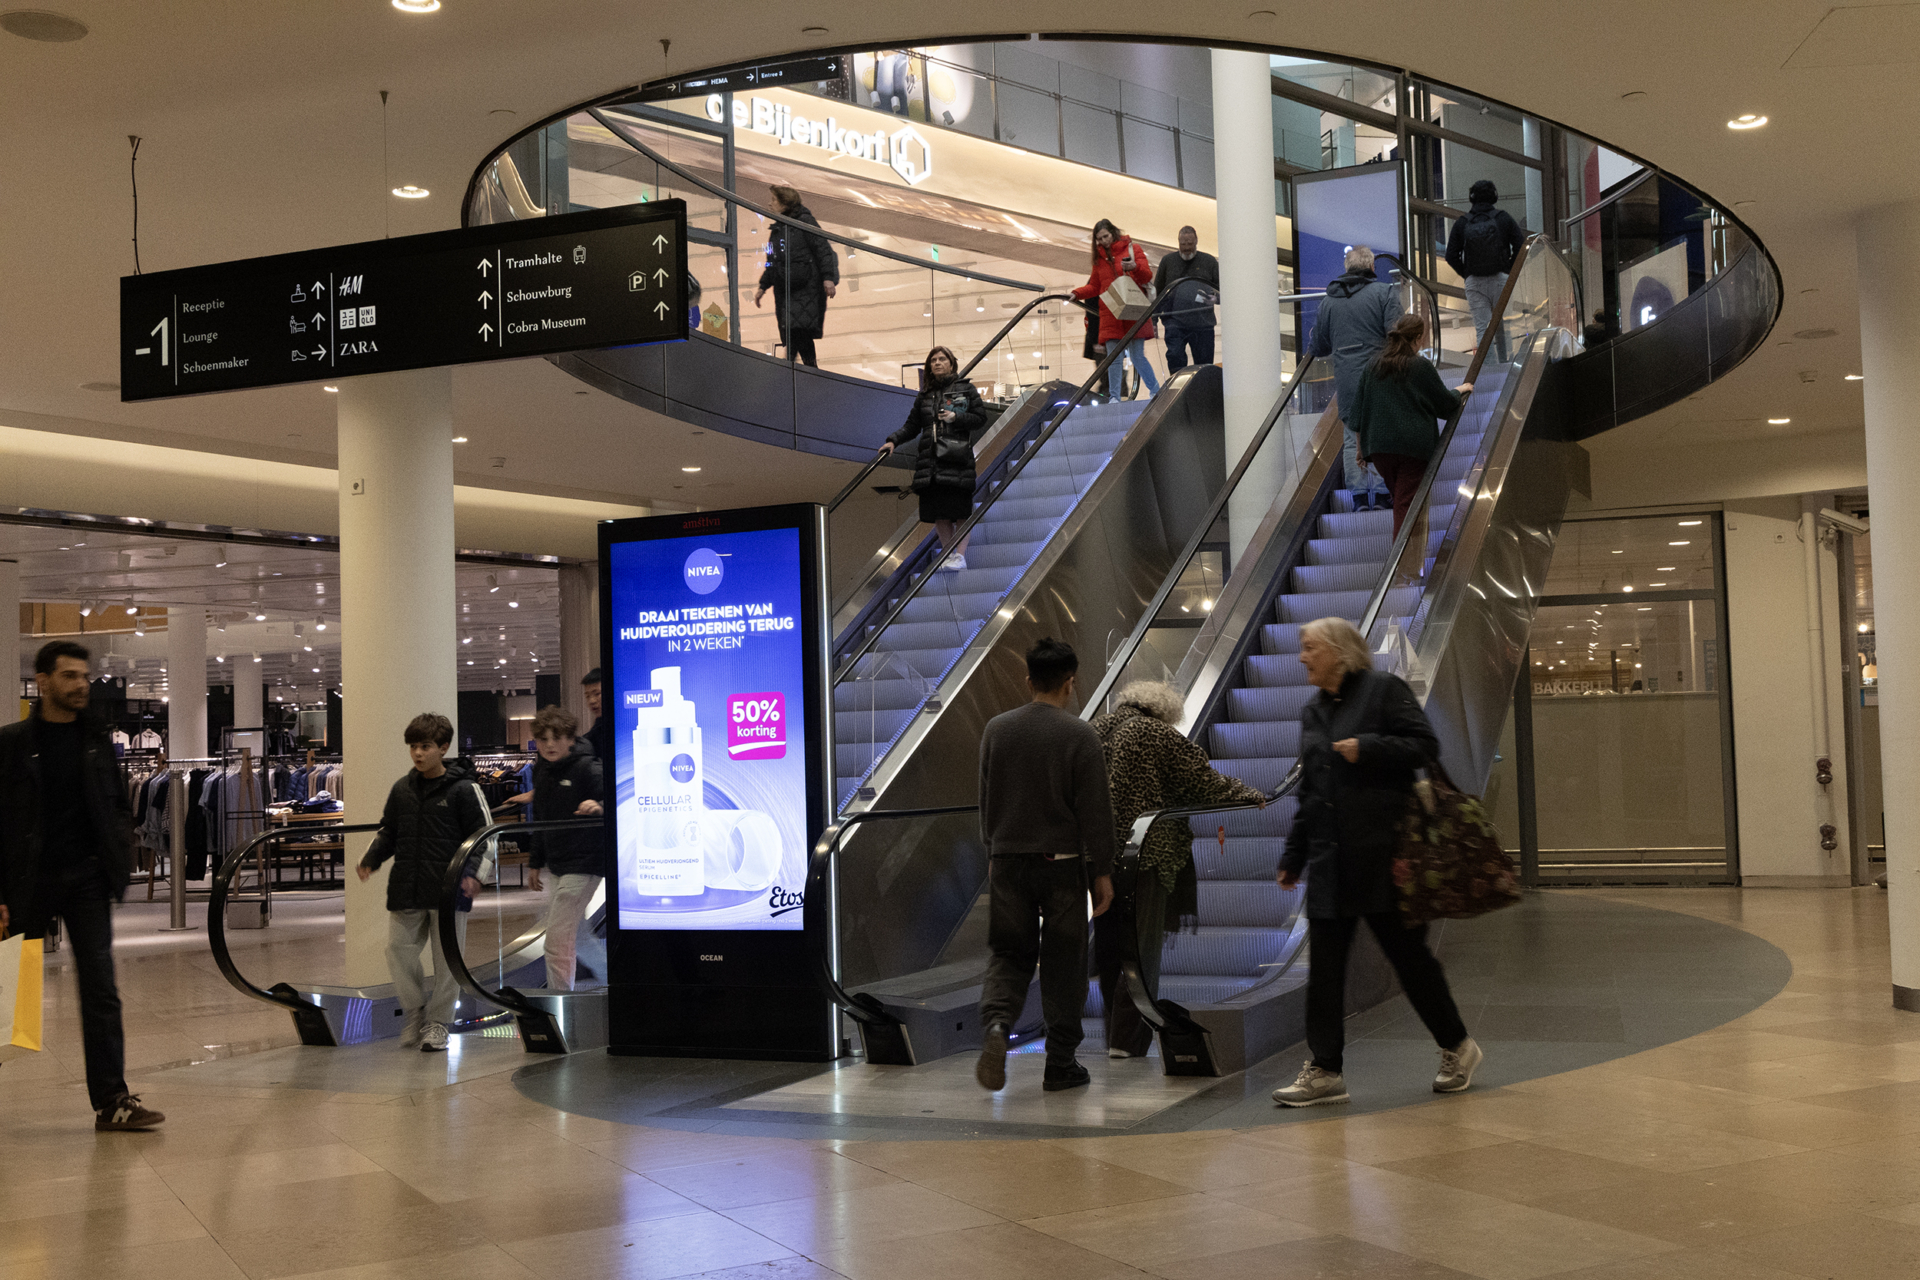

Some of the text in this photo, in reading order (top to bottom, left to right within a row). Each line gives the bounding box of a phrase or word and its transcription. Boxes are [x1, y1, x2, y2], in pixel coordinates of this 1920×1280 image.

[710, 77, 729, 86] HEMA
[760, 71, 778, 80] Entree
[751, 97, 886, 163] Bijenkorf
[506, 252, 563, 269] Tramhalte
[339, 274, 363, 297] H&M
[506, 285, 572, 303] Schouwburg
[182, 298, 225, 313] Receptie
[507, 317, 586, 334] Cobra Museum
[135, 316, 169, 367] -1
[183, 332, 219, 344] Lounge
[340, 340, 379, 356] ZARA
[183, 356, 250, 374] Schoenmaker
[687, 566, 721, 578] NIVEA
[639, 603, 773, 625] DRAAI TEKENEN VAN
[620, 617, 794, 641] HUIDVEROUDERING TERUG
[668, 640, 681, 653] IN
[684, 639, 692, 652] 2
[626, 693, 661, 705] NIEUW
[732, 698, 781, 723] 50%
[737, 724, 777, 739] korting
[672, 764, 694, 772] NIVEA
[637, 794, 692, 806] CELLULAR
[769, 886, 804, 908] Etos
[700, 954, 723, 962] OCEAN
